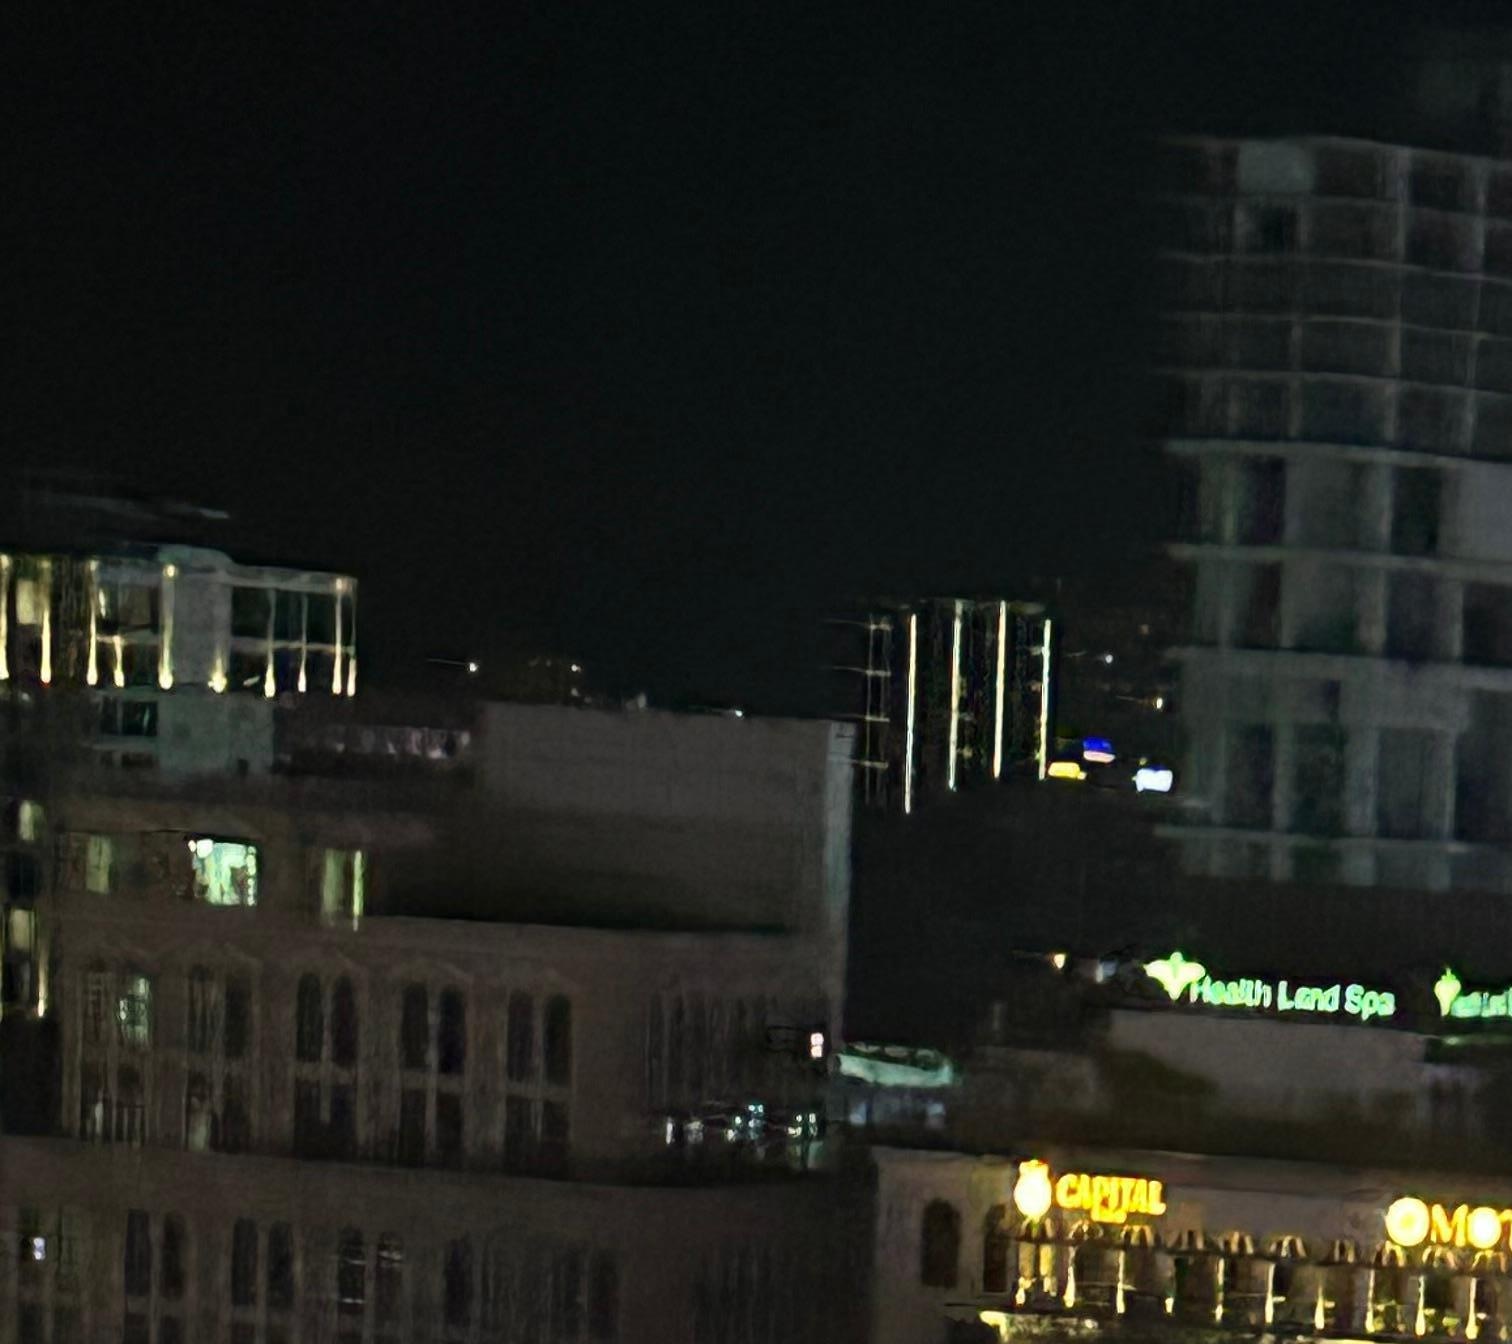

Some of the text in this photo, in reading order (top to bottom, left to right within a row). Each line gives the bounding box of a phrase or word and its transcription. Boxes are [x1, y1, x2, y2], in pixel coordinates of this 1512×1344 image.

[1277, 981, 1340, 1012] Land
[1344, 985, 1396, 1021] Spa
[1056, 1173, 1166, 1216] CAPITAL
